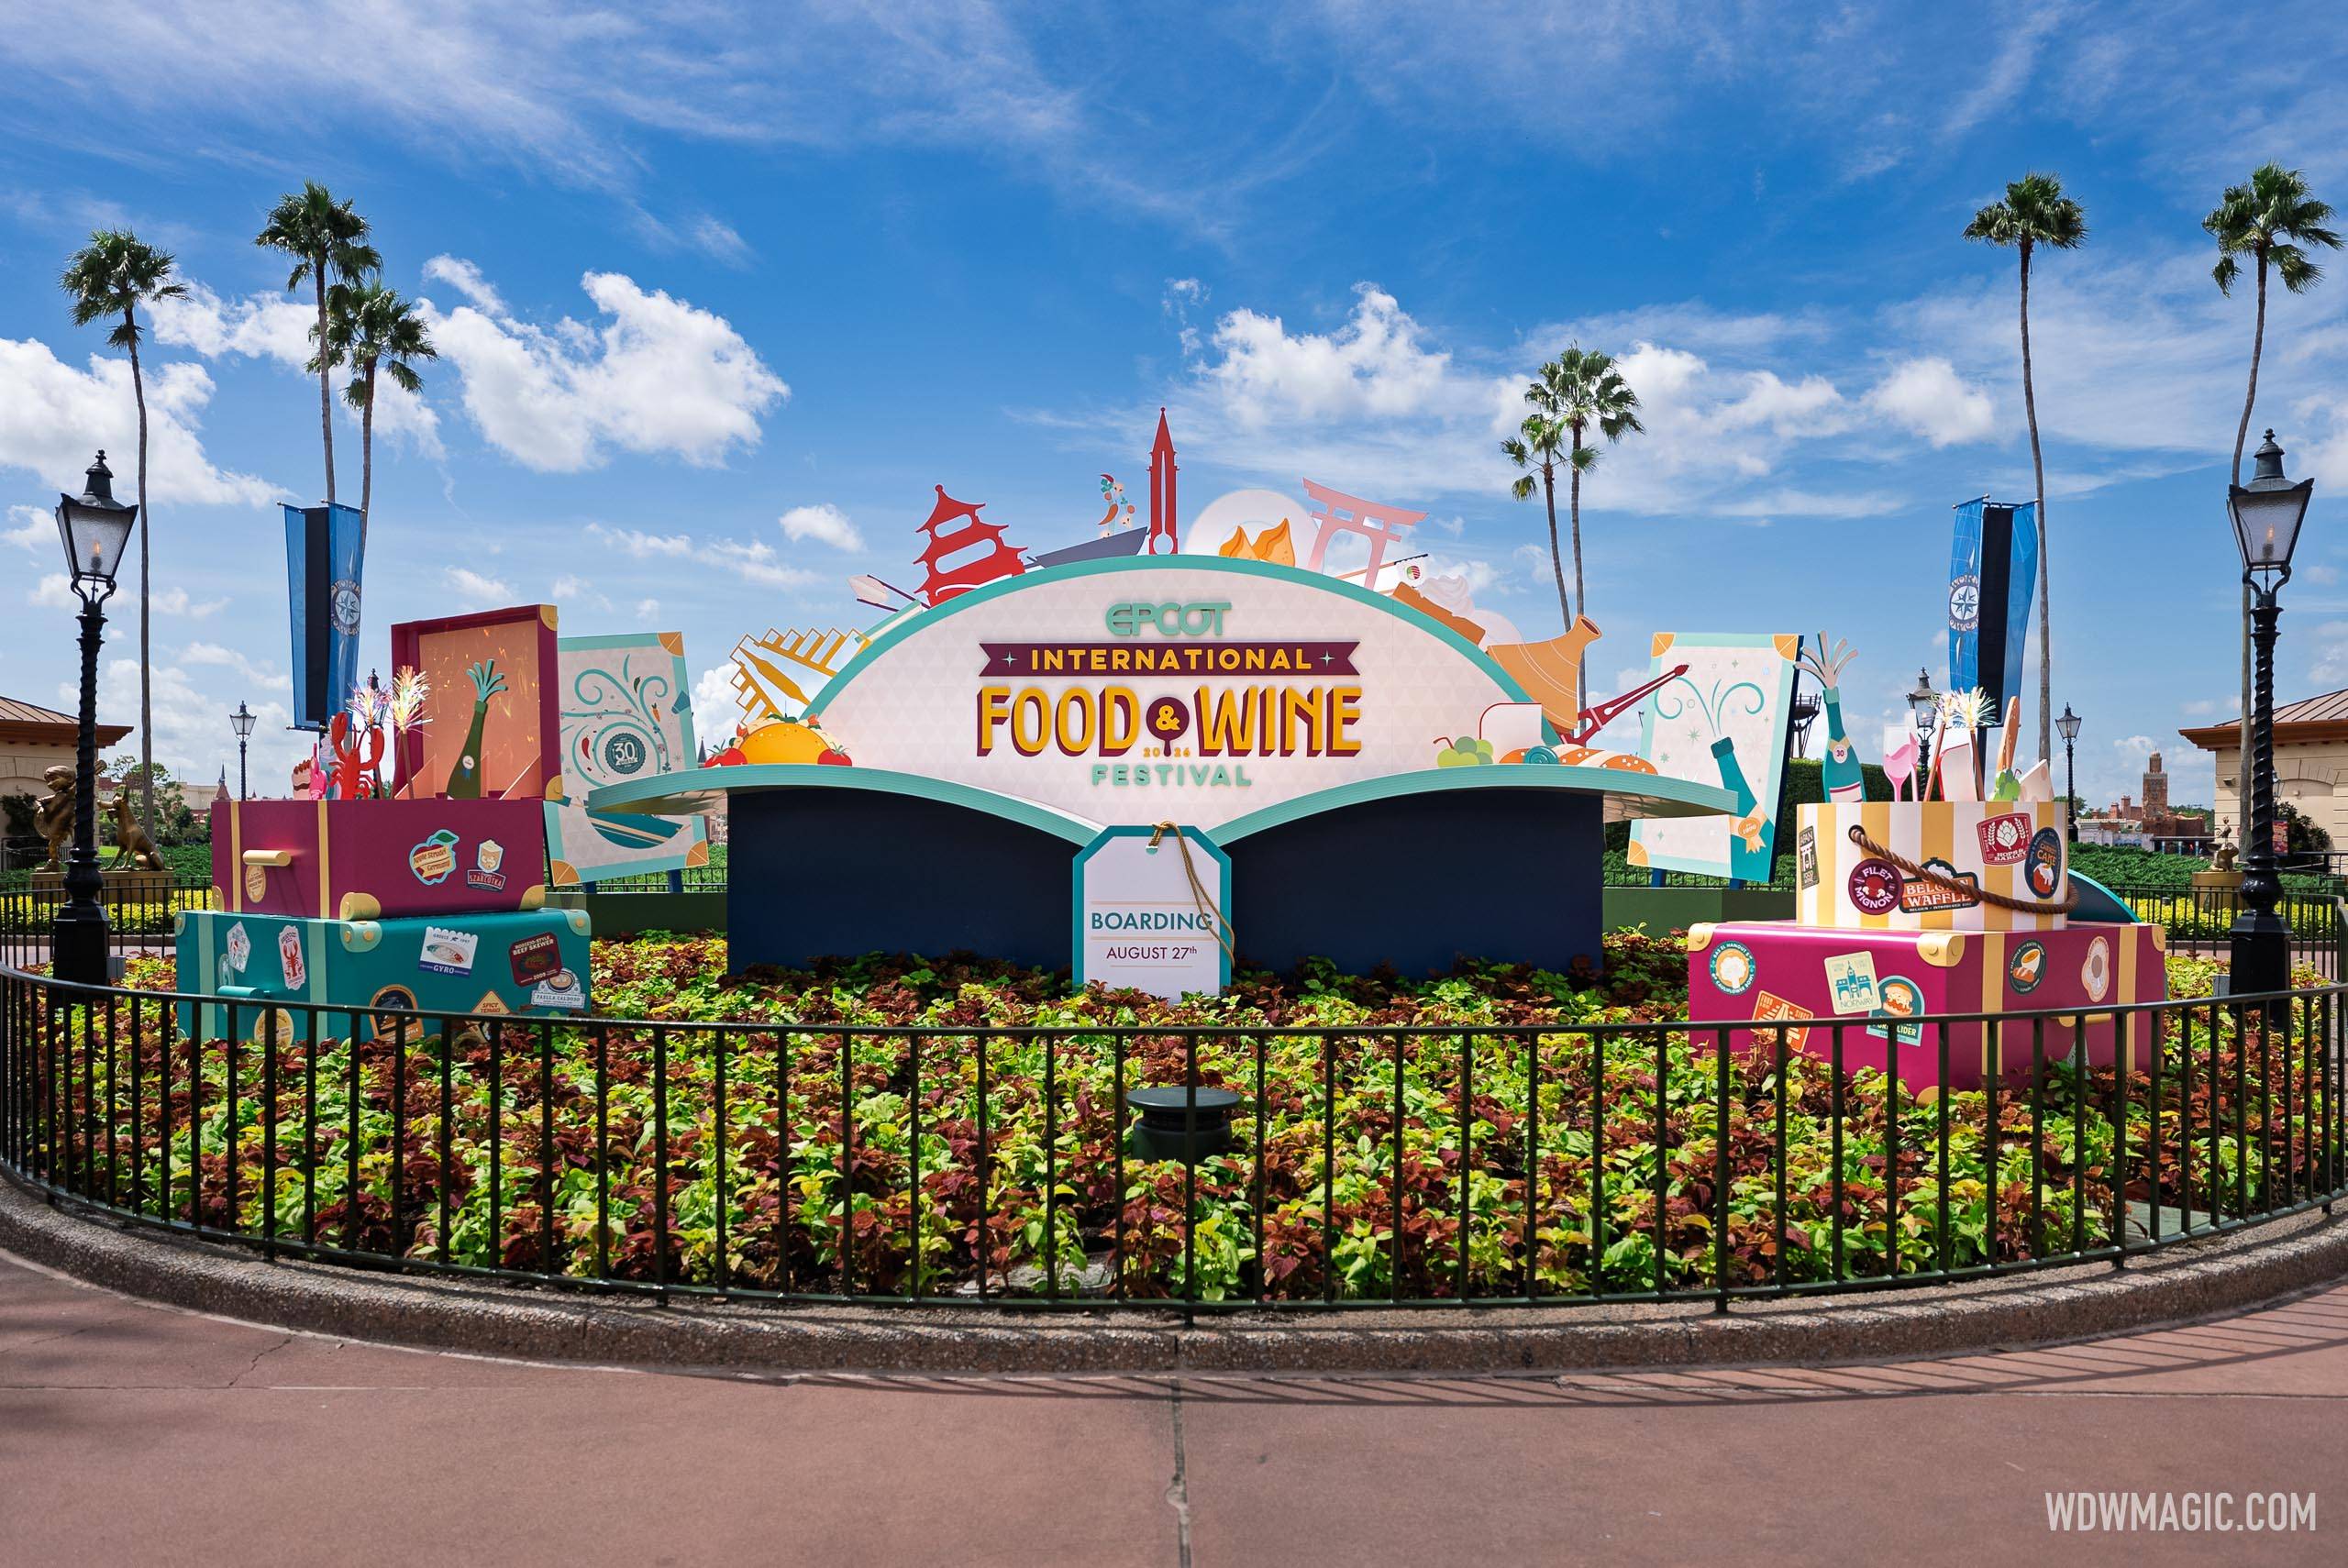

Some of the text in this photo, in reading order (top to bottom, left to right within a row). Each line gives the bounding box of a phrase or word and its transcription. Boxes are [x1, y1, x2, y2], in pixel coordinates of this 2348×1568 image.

[1105, 602, 1232, 635] EPCOT
[1031, 648, 1312, 670] INTERNATIONAL
[977, 685, 1362, 756] FOOD & WINE
[614, 741, 636, 761] 30
[1091, 764, 1252, 787] FESTIVAL
[2037, 850, 2056, 866] CAKE
[1862, 867, 1893, 880] FILET
[1855, 887, 1894, 909] MIGNON
[1091, 912, 1213, 931] BOARDING
[513, 939, 554, 955] BEEF SKEWER
[1106, 946, 1198, 959] AUGUST 27th
[433, 965, 454, 974] GYRO
[1841, 998, 1873, 1008] NORWAY
[1897, 1025, 1917, 1036] LIDER
